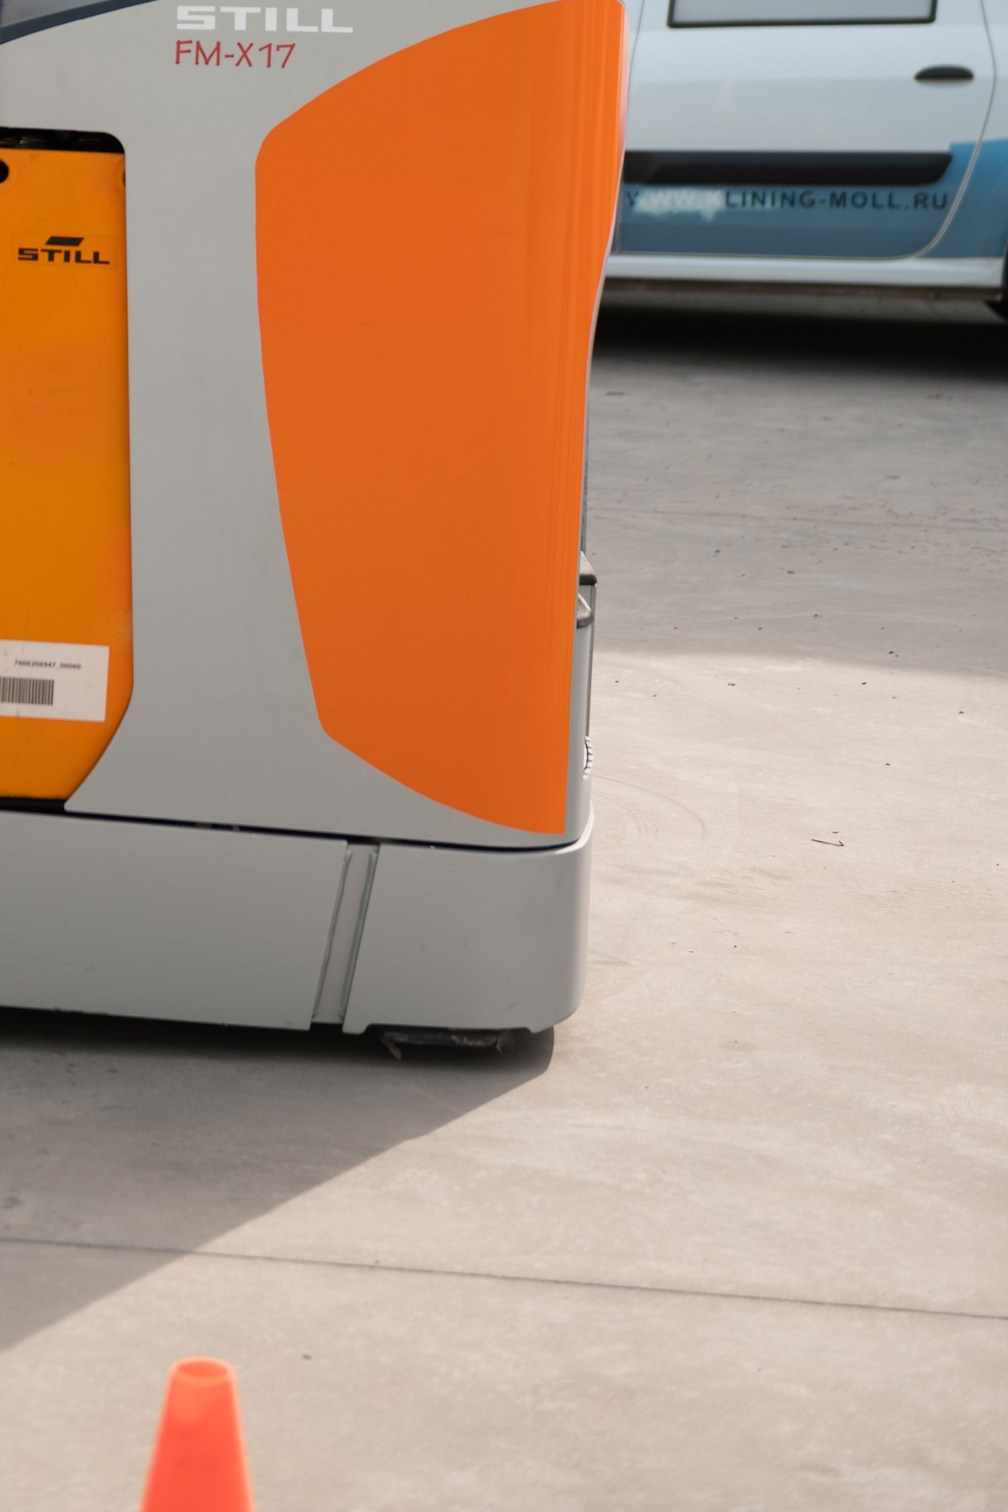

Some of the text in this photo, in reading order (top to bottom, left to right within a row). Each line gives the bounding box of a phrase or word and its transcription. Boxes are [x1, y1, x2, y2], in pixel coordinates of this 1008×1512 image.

[176, 5, 354, 33] STILL
[175, 39, 296, 68] FM-X17
[17, 247, 110, 265] STILL
